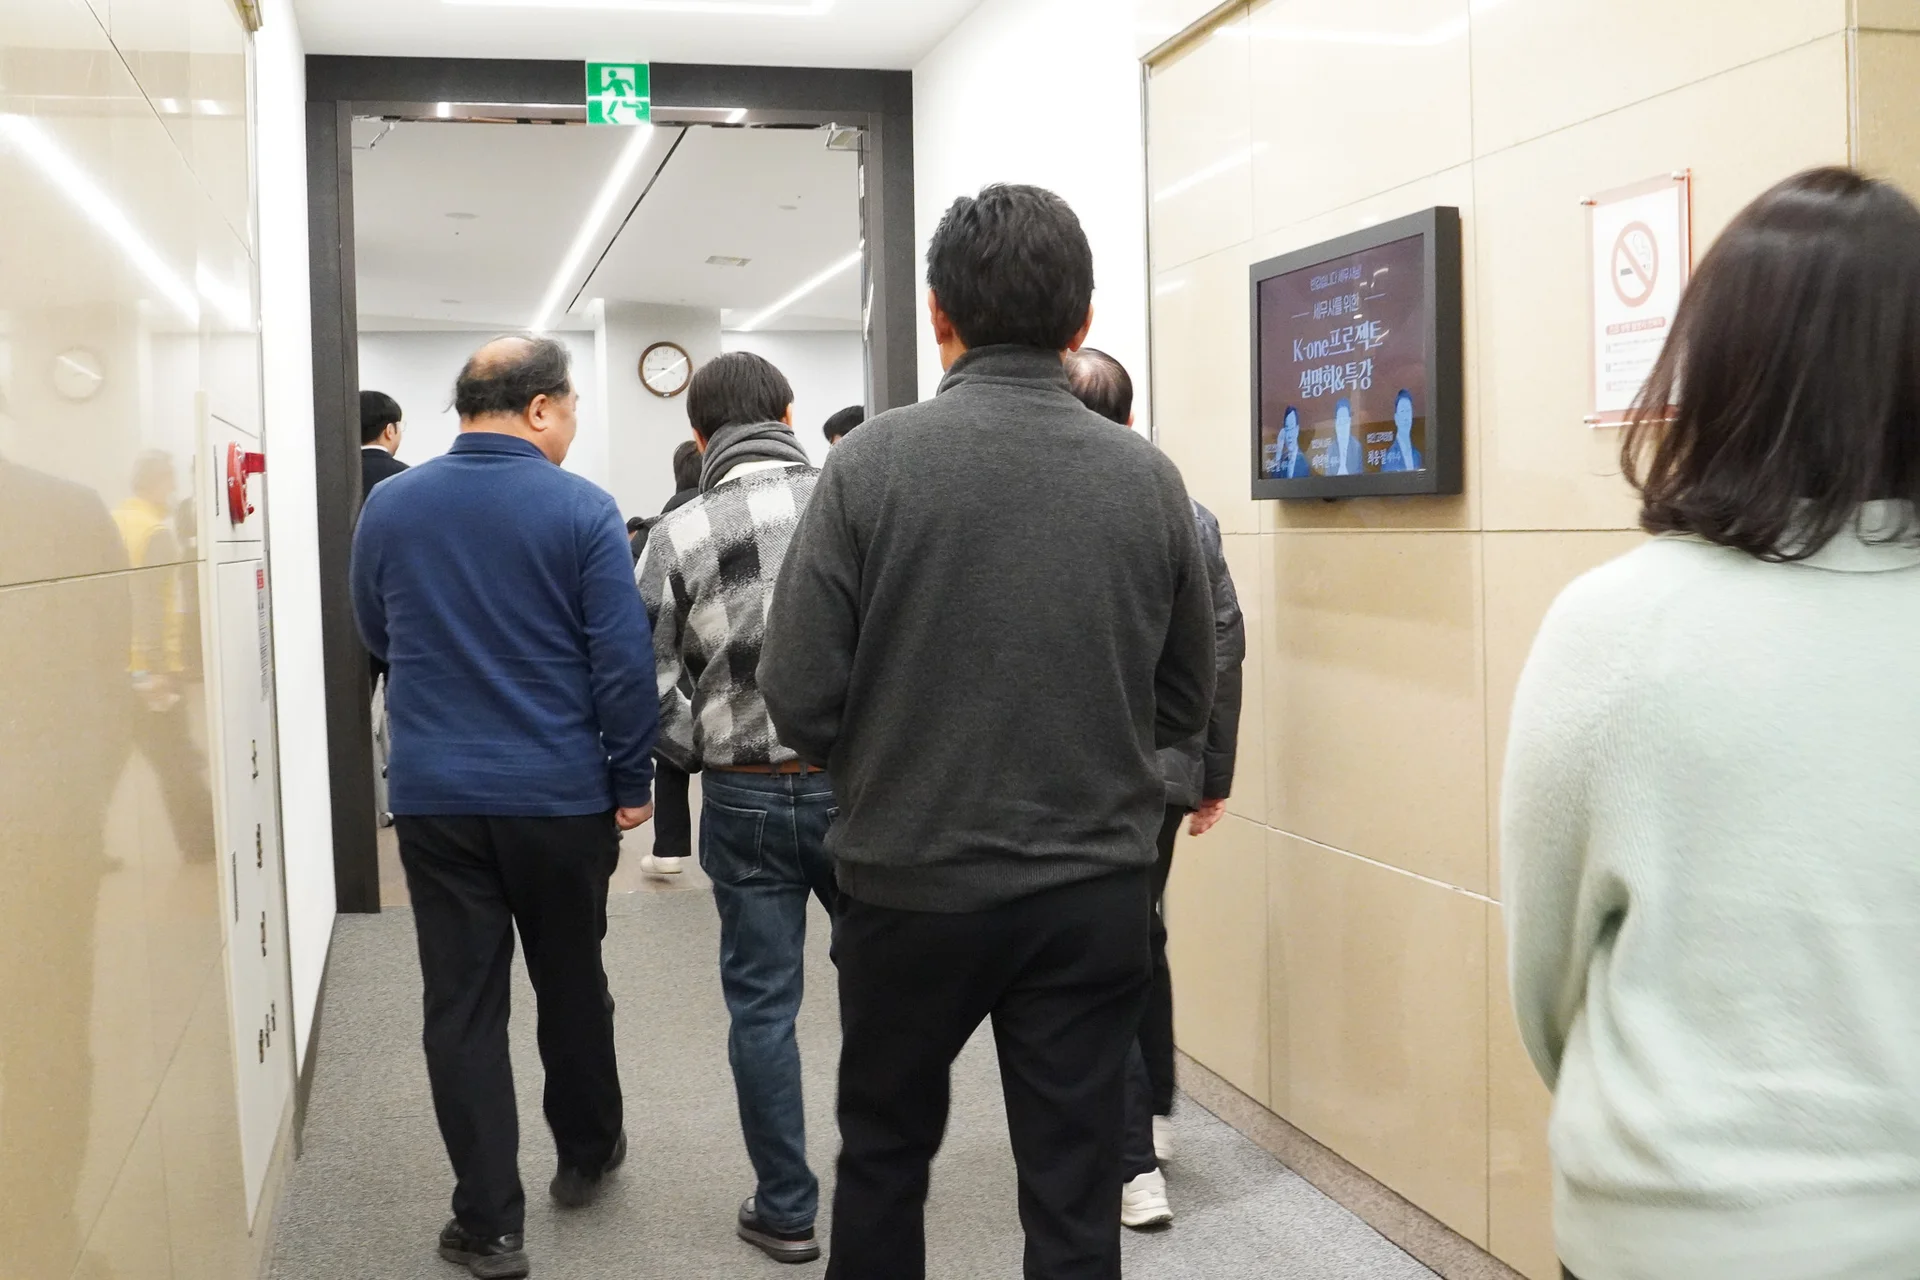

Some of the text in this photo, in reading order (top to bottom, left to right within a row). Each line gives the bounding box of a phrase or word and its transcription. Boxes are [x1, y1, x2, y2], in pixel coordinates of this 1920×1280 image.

[1313, 292, 1360, 320] 세무사를 위한
[1298, 358, 1374, 399] 설명회&특강
